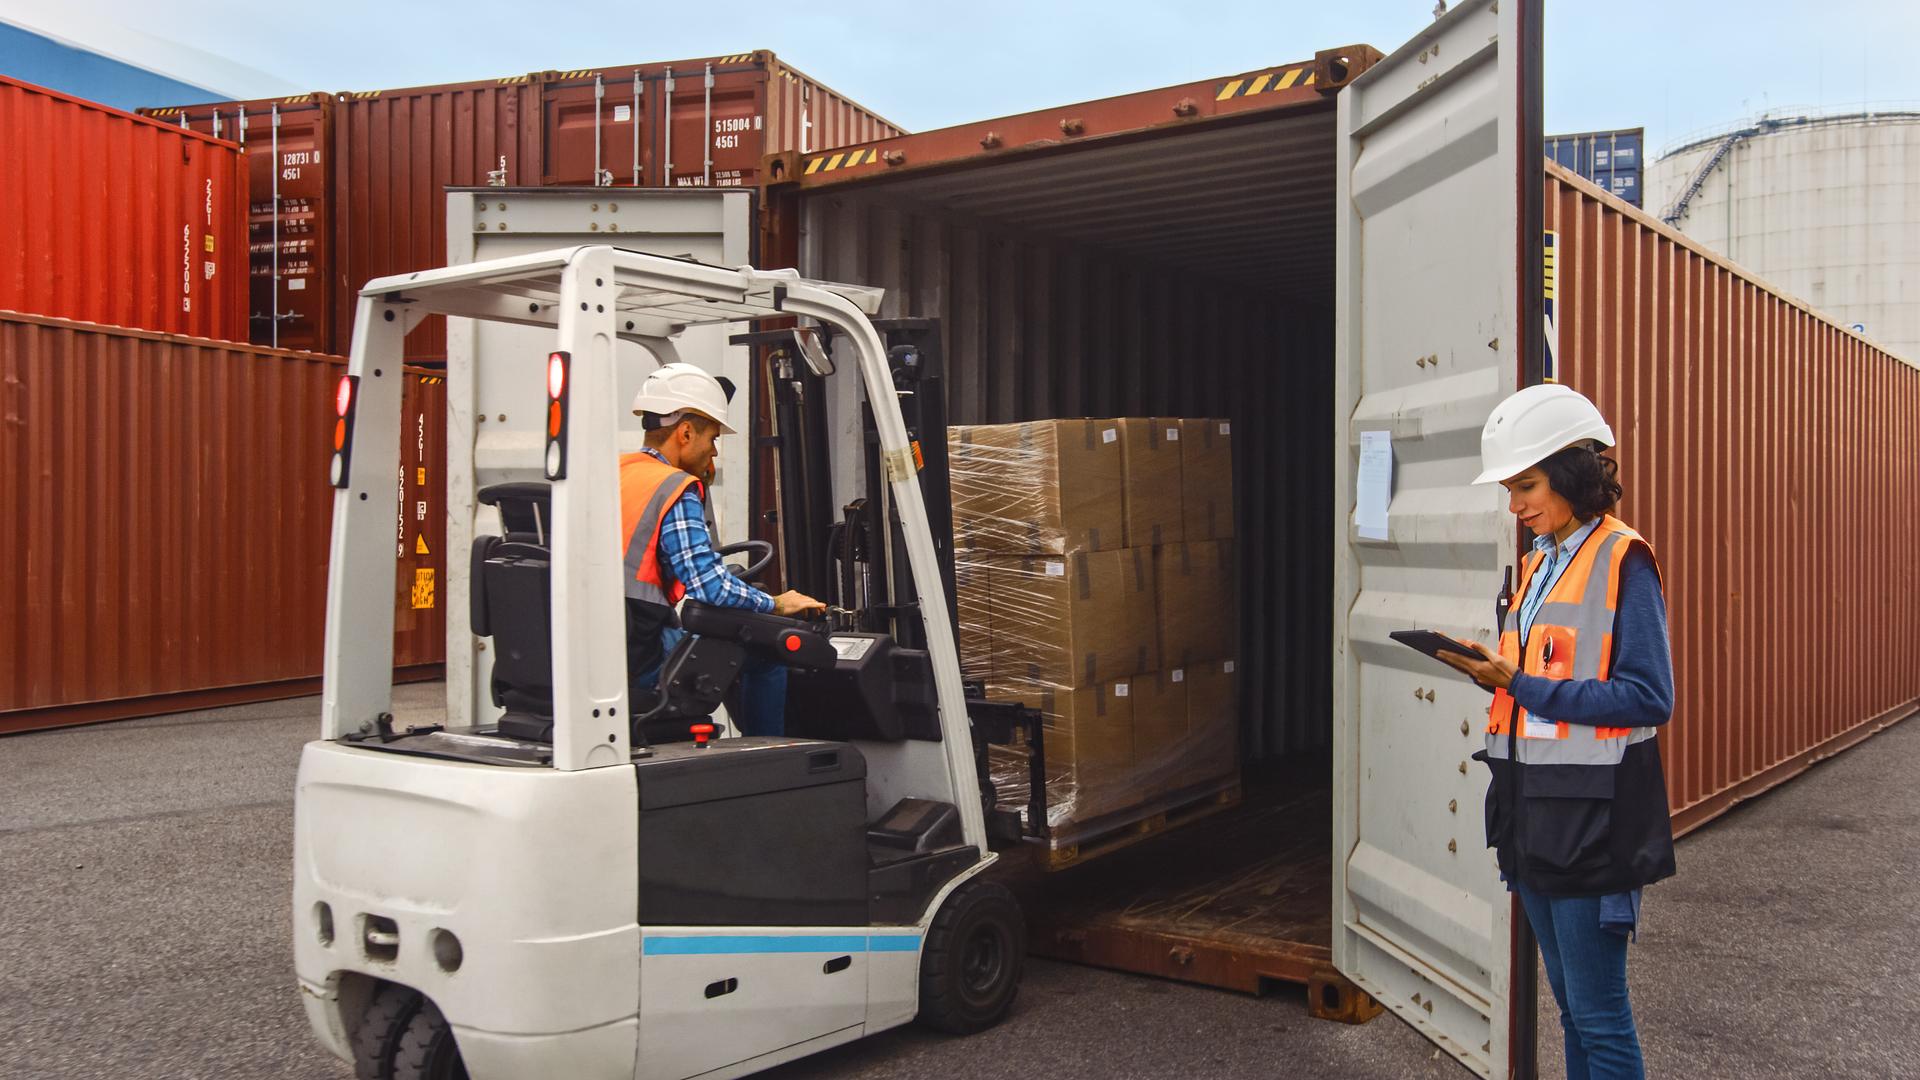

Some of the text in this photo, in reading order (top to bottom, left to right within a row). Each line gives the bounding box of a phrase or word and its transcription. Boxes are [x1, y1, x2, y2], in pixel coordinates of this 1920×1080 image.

[715, 116, 762, 133] 515004 0
[715, 135, 738, 149] 45G1
[283, 151, 320, 166] 128731 0
[283, 168, 300, 180] 45G1
[732, 178, 742, 186] LBS
[398, 543, 404, 558] 9
